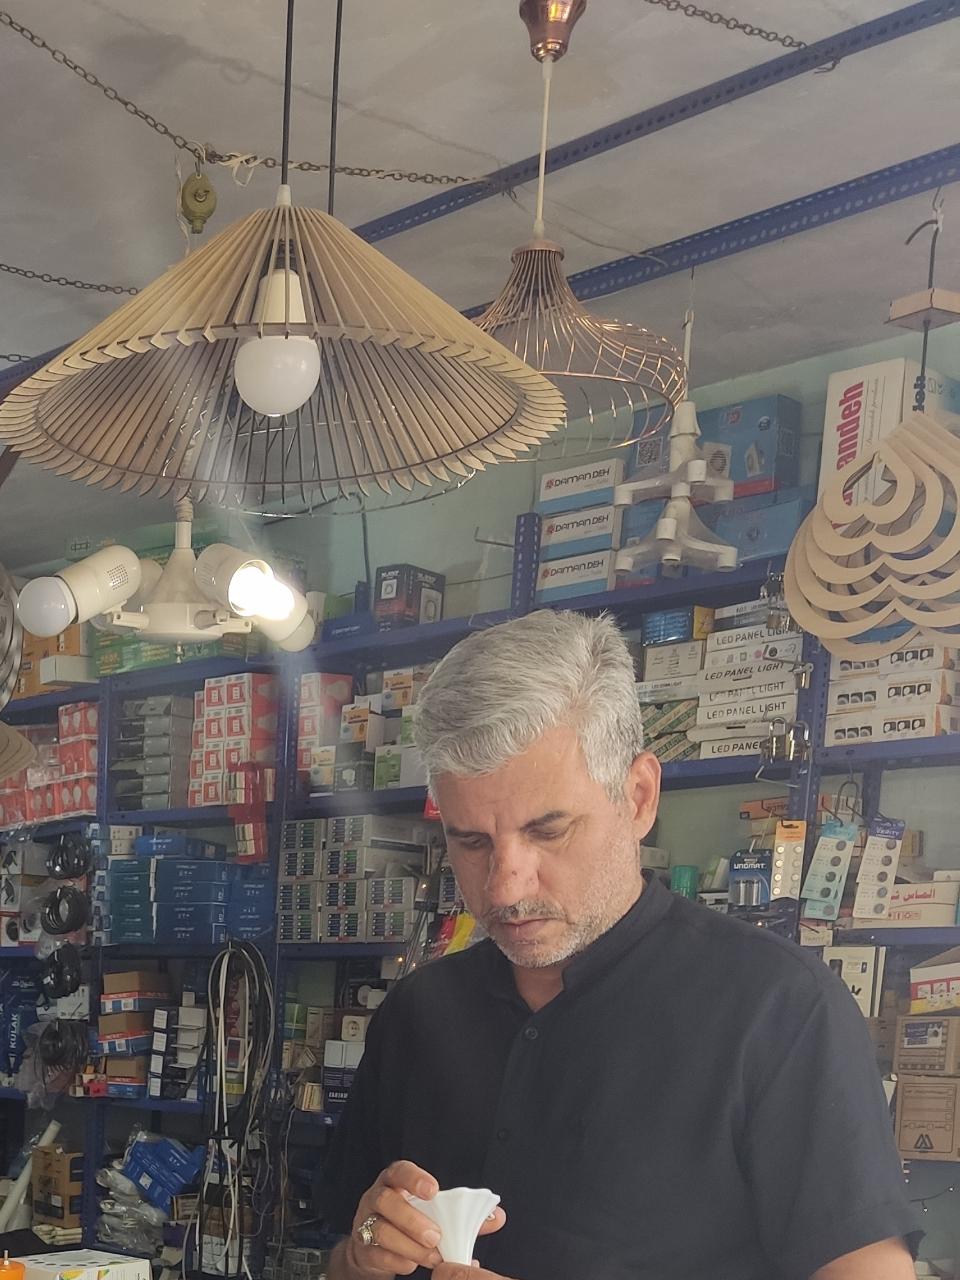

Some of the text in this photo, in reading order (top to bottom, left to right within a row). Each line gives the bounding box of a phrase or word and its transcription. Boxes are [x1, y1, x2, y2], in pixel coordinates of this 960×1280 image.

[716, 635, 734, 646] LED
[734, 631, 765, 643] PANEL
[704, 662, 785, 681] LED PANEL LIGHT
[759, 682, 785, 693] LIGHT
[759, 701, 787, 713] LIGHT
[711, 744, 730, 754] LED
[9, 1013, 19, 1049] KULAK
